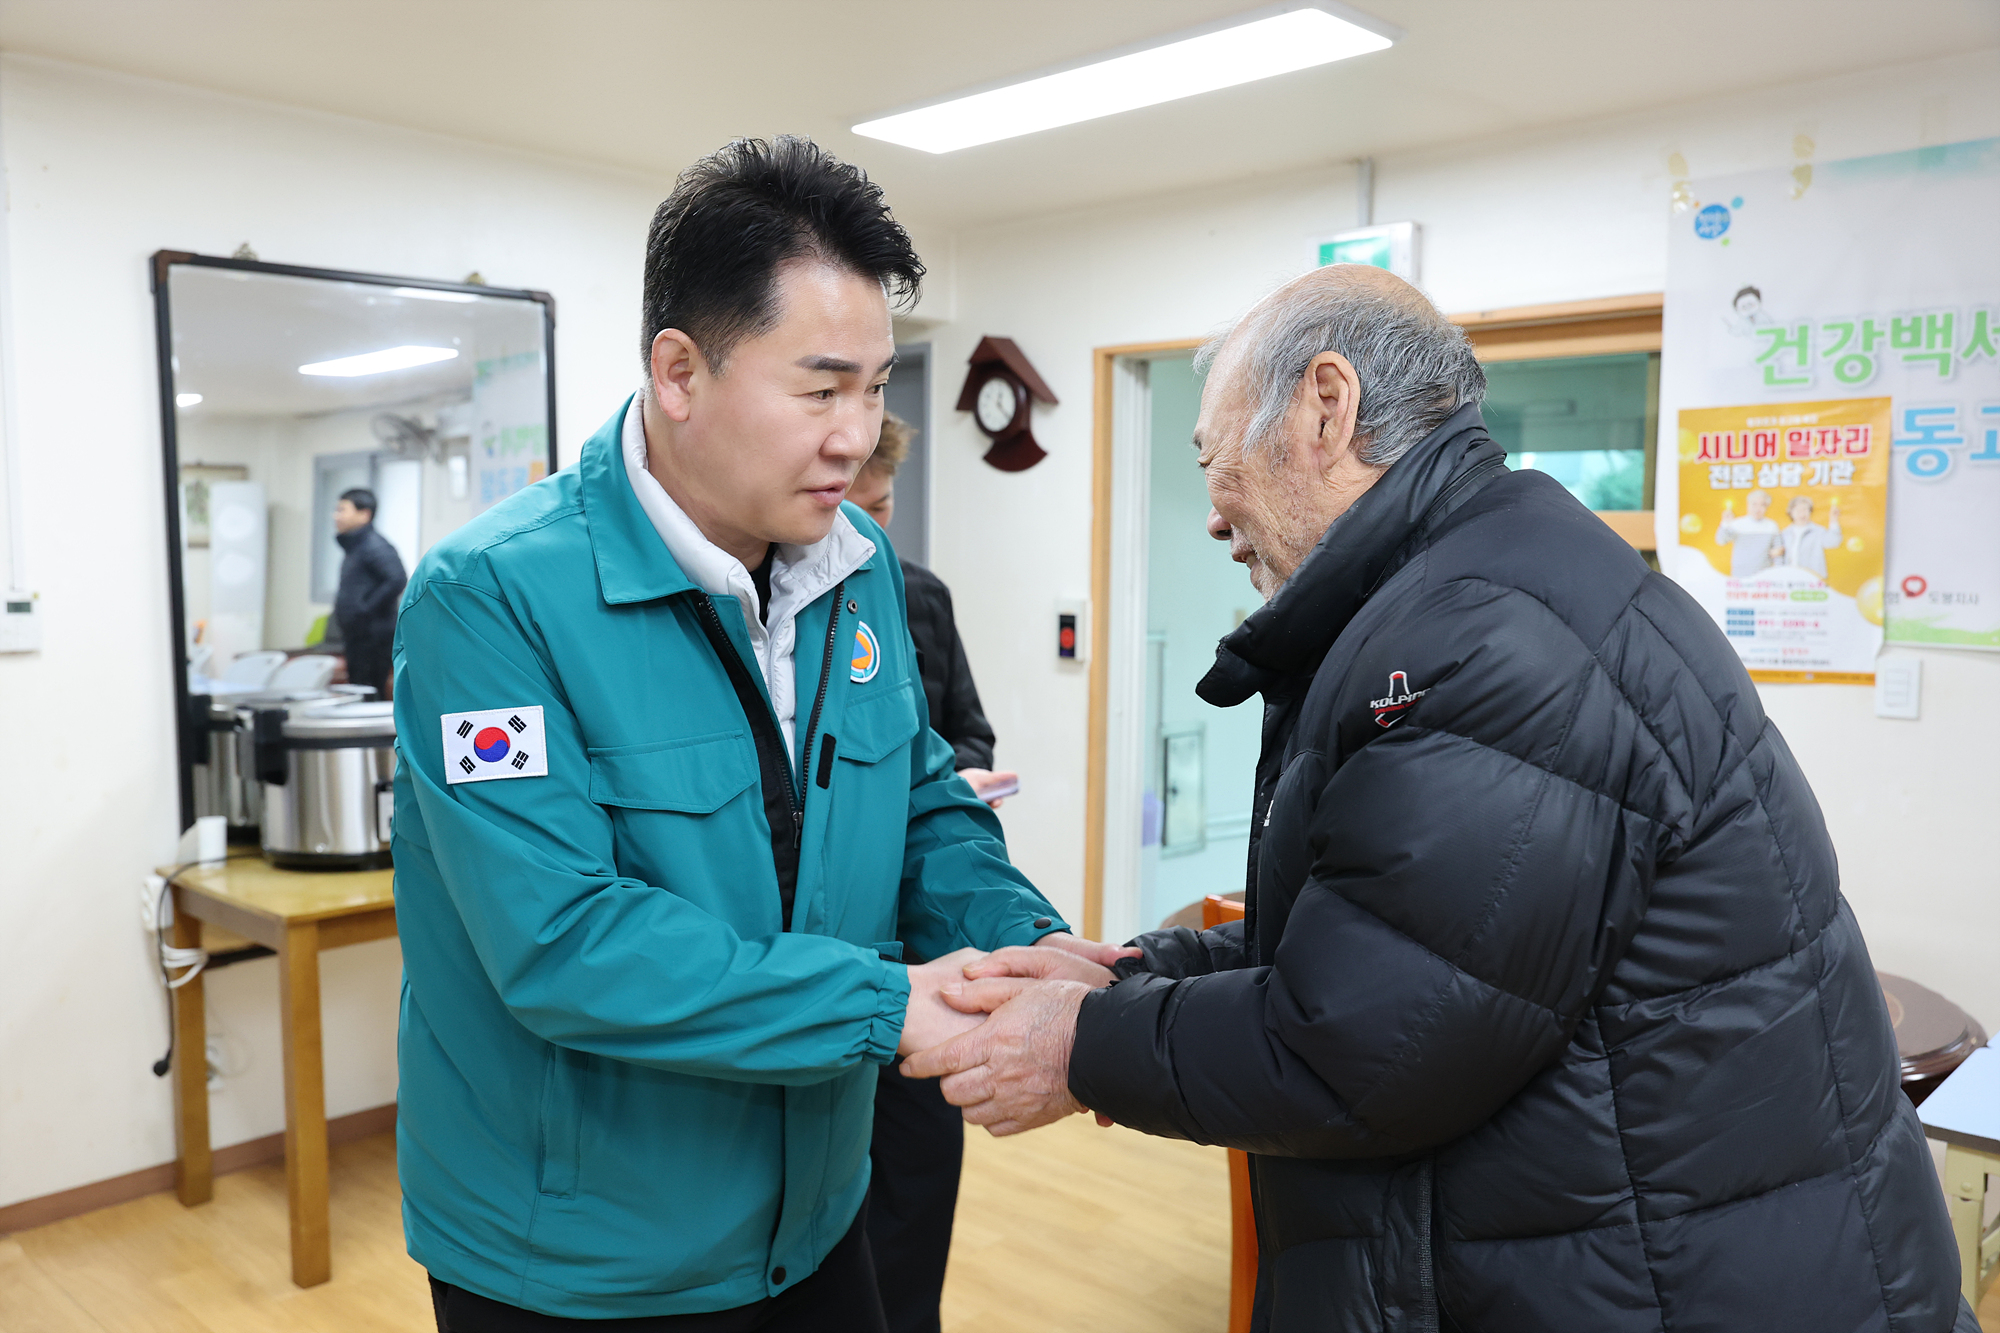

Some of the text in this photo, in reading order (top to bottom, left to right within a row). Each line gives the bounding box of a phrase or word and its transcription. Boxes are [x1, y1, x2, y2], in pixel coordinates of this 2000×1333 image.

[1697, 427, 1870, 461] 시니어 일자리
[1708, 460, 1855, 489] 전문 상담 기관
